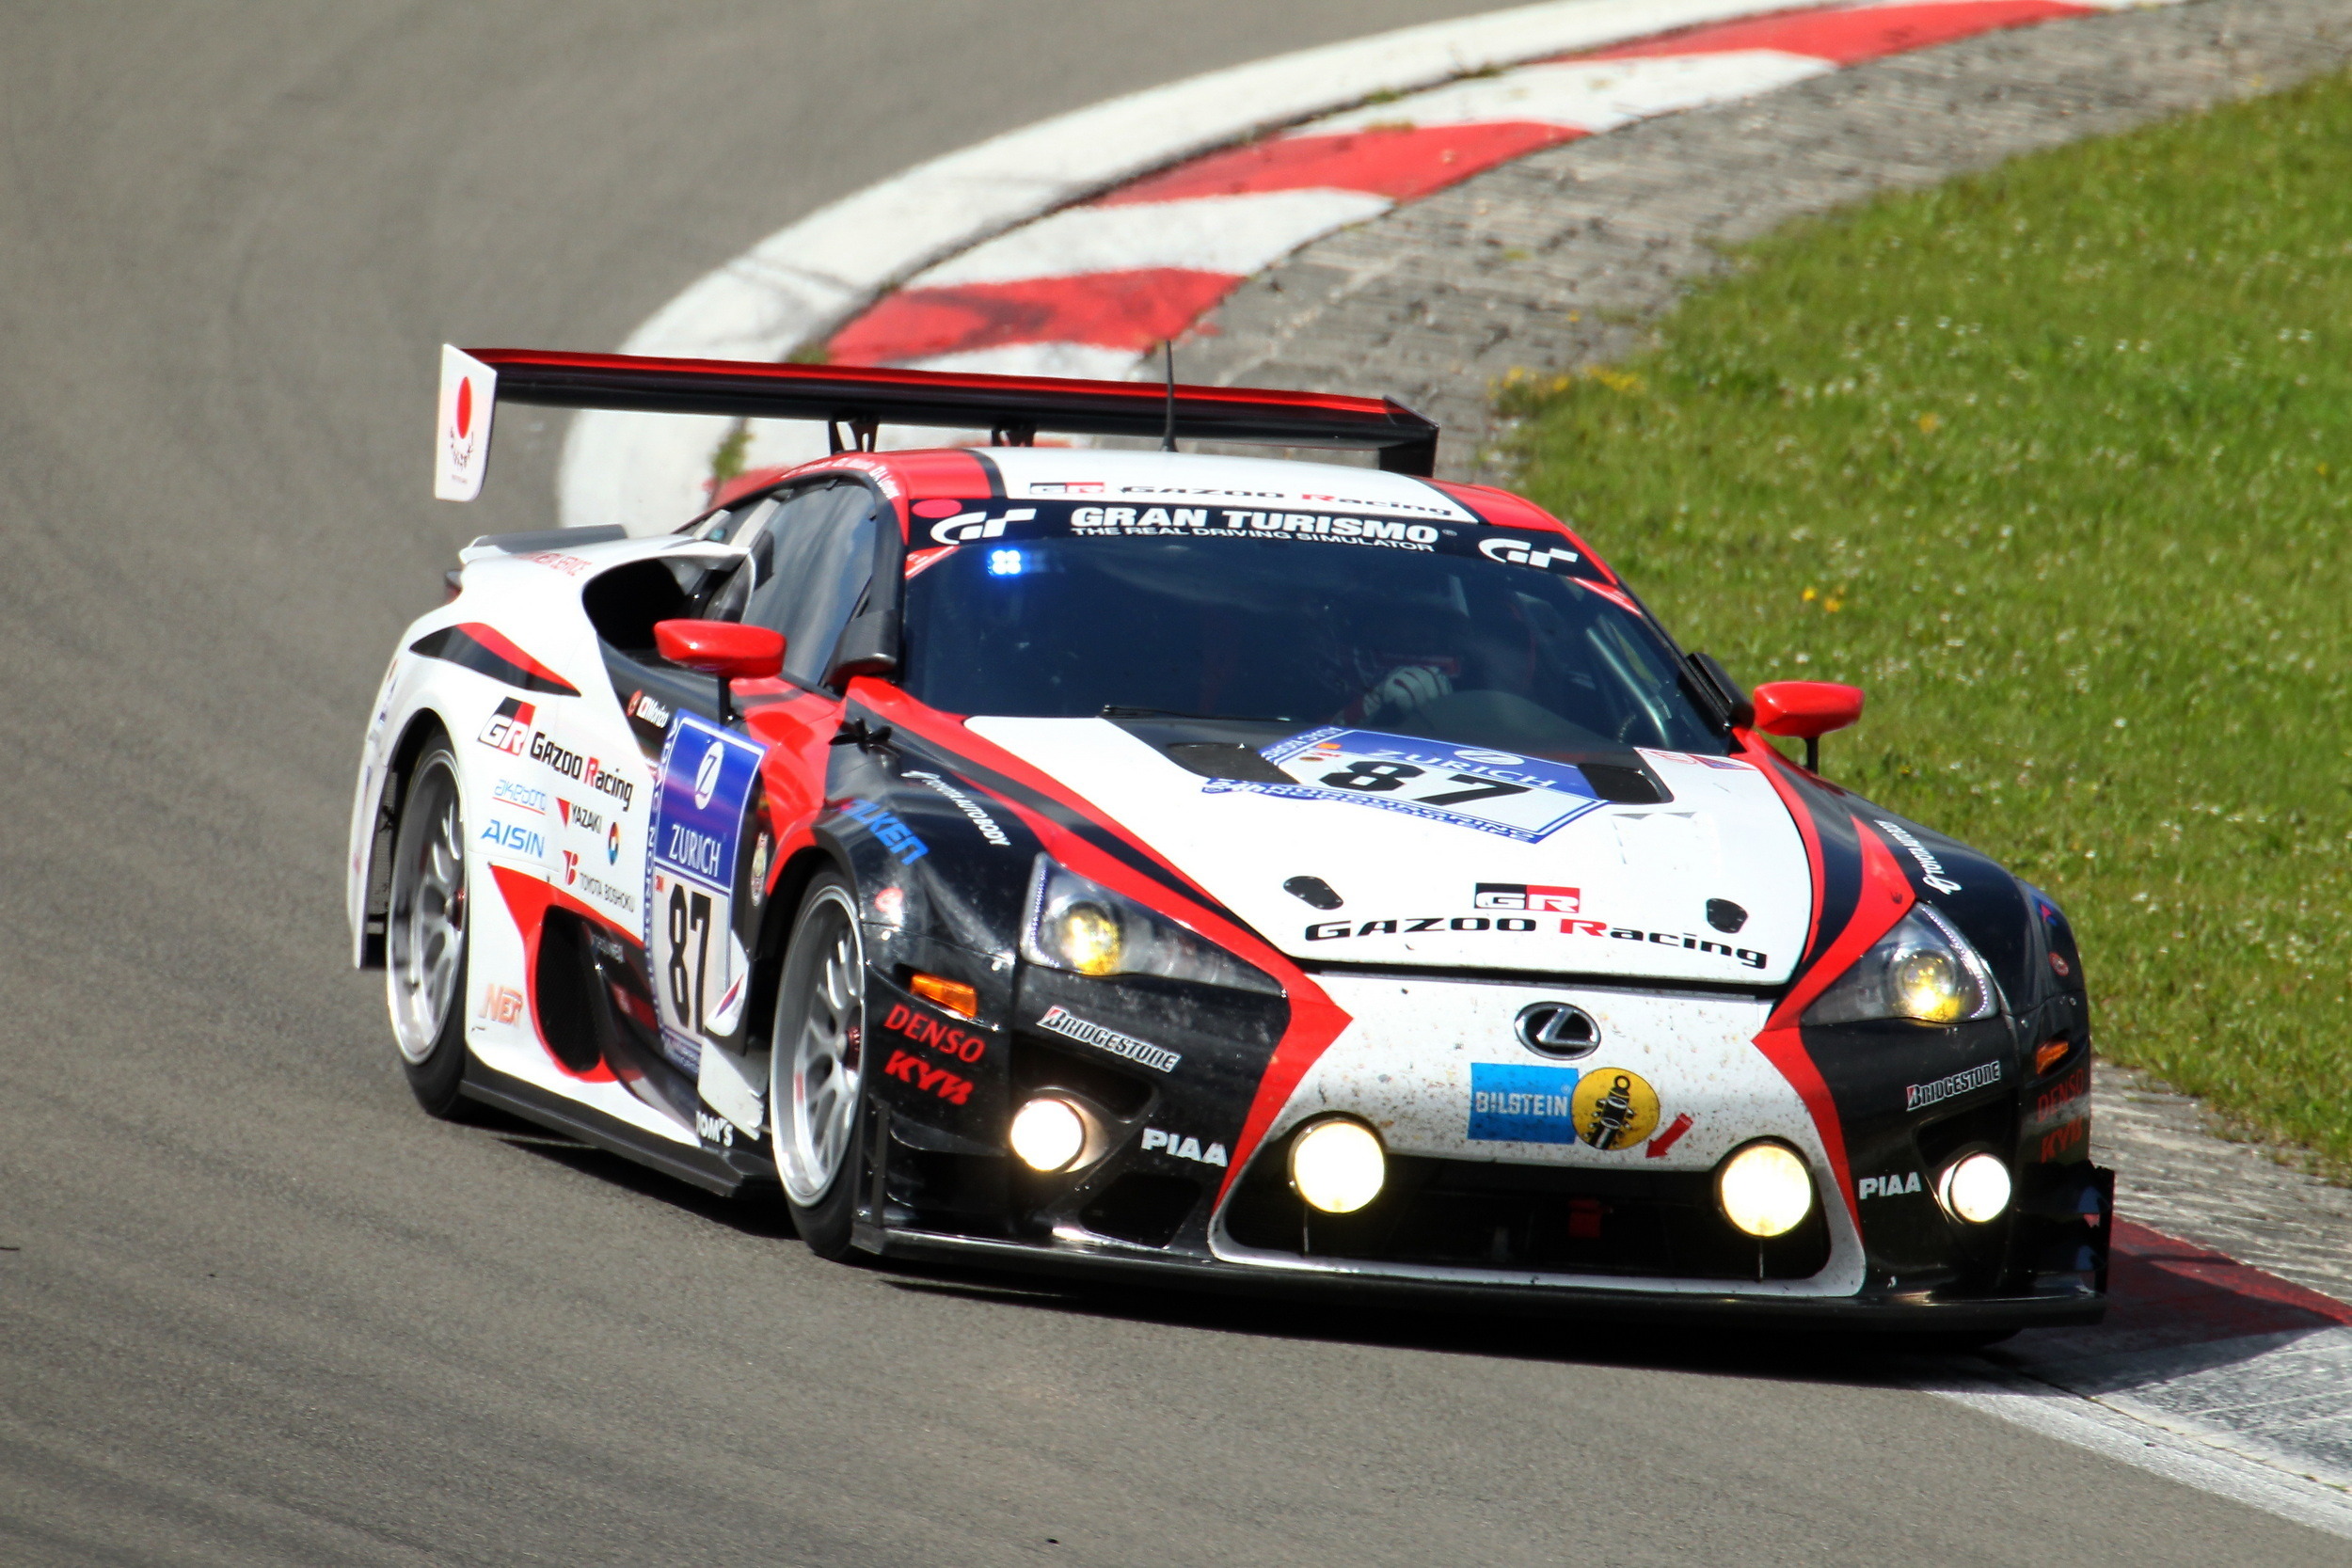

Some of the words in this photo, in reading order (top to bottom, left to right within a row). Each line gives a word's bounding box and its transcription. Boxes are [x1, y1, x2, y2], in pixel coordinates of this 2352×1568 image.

[1122, 486, 1284, 499] GAZOO
[1302, 494, 1452, 516] Racing
[1071, 507, 1208, 527] GRAN
[1221, 511, 1439, 544] TURISMO
[1072, 528, 1121, 536] THE
[1127, 528, 1190, 536] REAL
[1192, 528, 1293, 540] DRIVING
[1295, 532, 1436, 552] SIMULATOR
[479, 712, 530, 756] GR
[530, 731, 582, 779] GAZOO
[583, 756, 634, 812] Racing
[1318, 761, 1533, 806] 87
[1367, 750, 1557, 789] ZURICH
[481, 819, 545, 858] AISIN
[571, 803, 602, 834] YAZAKI
[669, 823, 722, 878] ZURICH
[1474, 883, 1581, 912] GR
[669, 882, 712, 1036] 87
[1305, 917, 1537, 942] GAZOO
[1559, 917, 1769, 970] Racing
[883, 1003, 987, 1064] DENSO
[1036, 1005, 1182, 1074] BRIDGESTONE
[884, 1049, 976, 1106] KYB
[1906, 1060, 2001, 1112] BRIDGESTONE
[2037, 1069, 2084, 1123] DENSO
[1475, 1091, 1568, 1117] BILSTEIN
[1141, 1128, 1230, 1167] PIAA
[2041, 1115, 2083, 1164] KYB
[1859, 1172, 1922, 1199] PIAA
